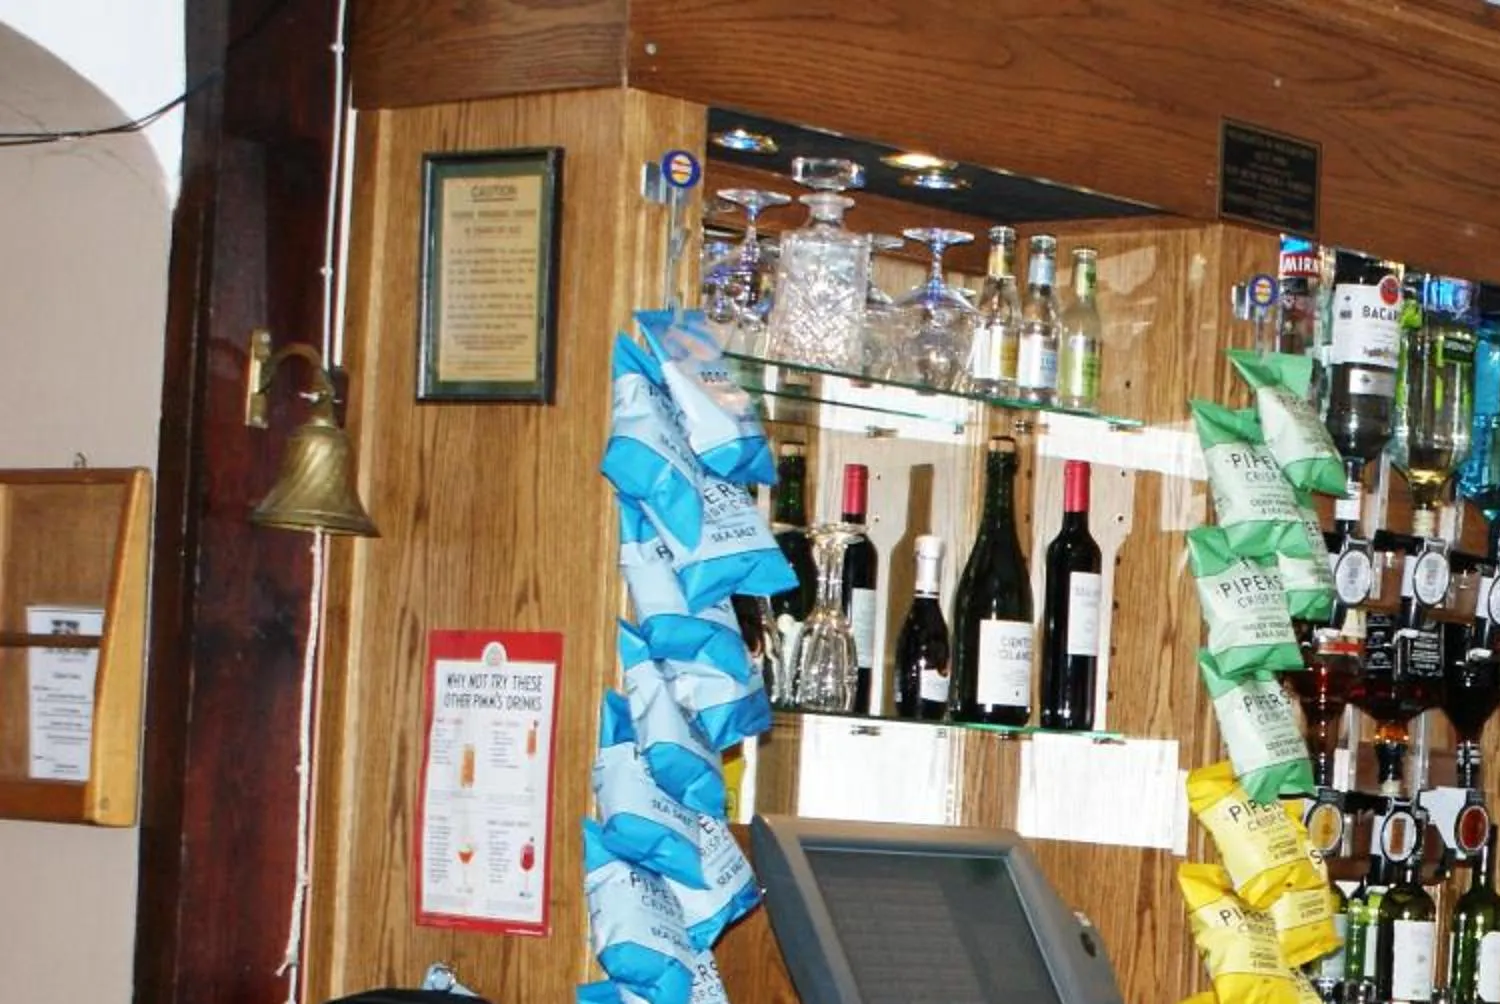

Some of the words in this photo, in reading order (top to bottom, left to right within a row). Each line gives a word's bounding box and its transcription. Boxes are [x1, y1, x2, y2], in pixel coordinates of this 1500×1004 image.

[1219, 575, 1284, 598] PIPERS
[447, 673, 467, 690] WHY
[469, 674, 489, 690] NOT
[491, 673, 509, 691] TRY
[512, 675, 544, 693] THESE
[443, 692, 471, 711] OTHER
[506, 695, 542, 711] DRINKS
